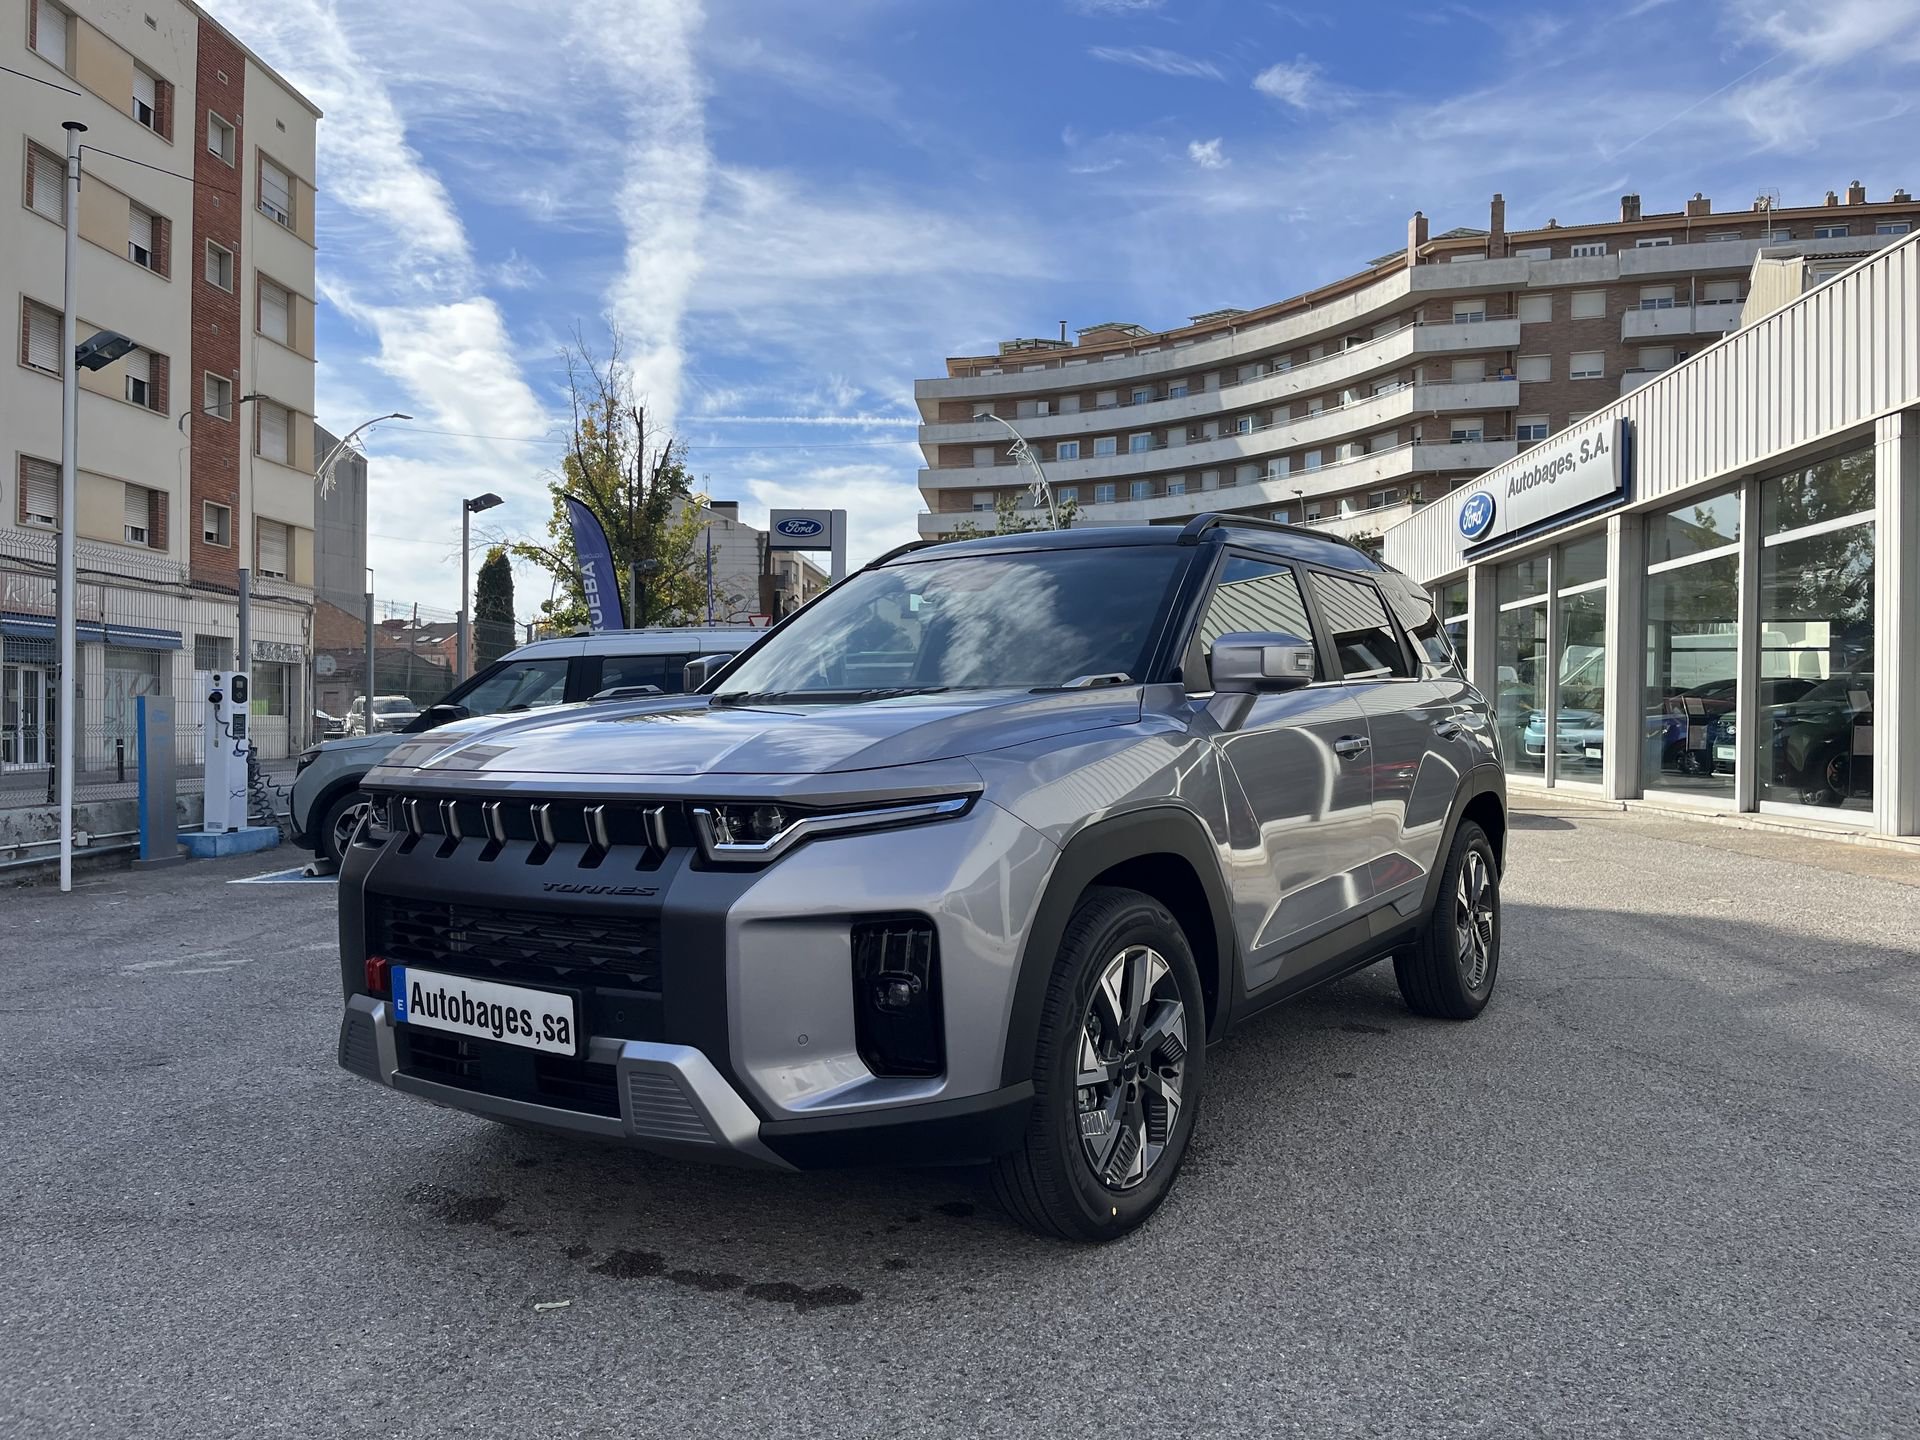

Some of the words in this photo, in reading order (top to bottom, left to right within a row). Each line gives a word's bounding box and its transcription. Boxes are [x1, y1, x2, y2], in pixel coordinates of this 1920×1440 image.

[1508, 452, 1576, 498] Autobages,
[1580, 432, 1609, 464] S.A.
[785, 520, 815, 533] Ford
[1463, 500, 1484, 530] Ford
[543, 881, 660, 897] TORRES
[397, 999, 405, 1011] E
[410, 981, 571, 1045] Autobages,sa
